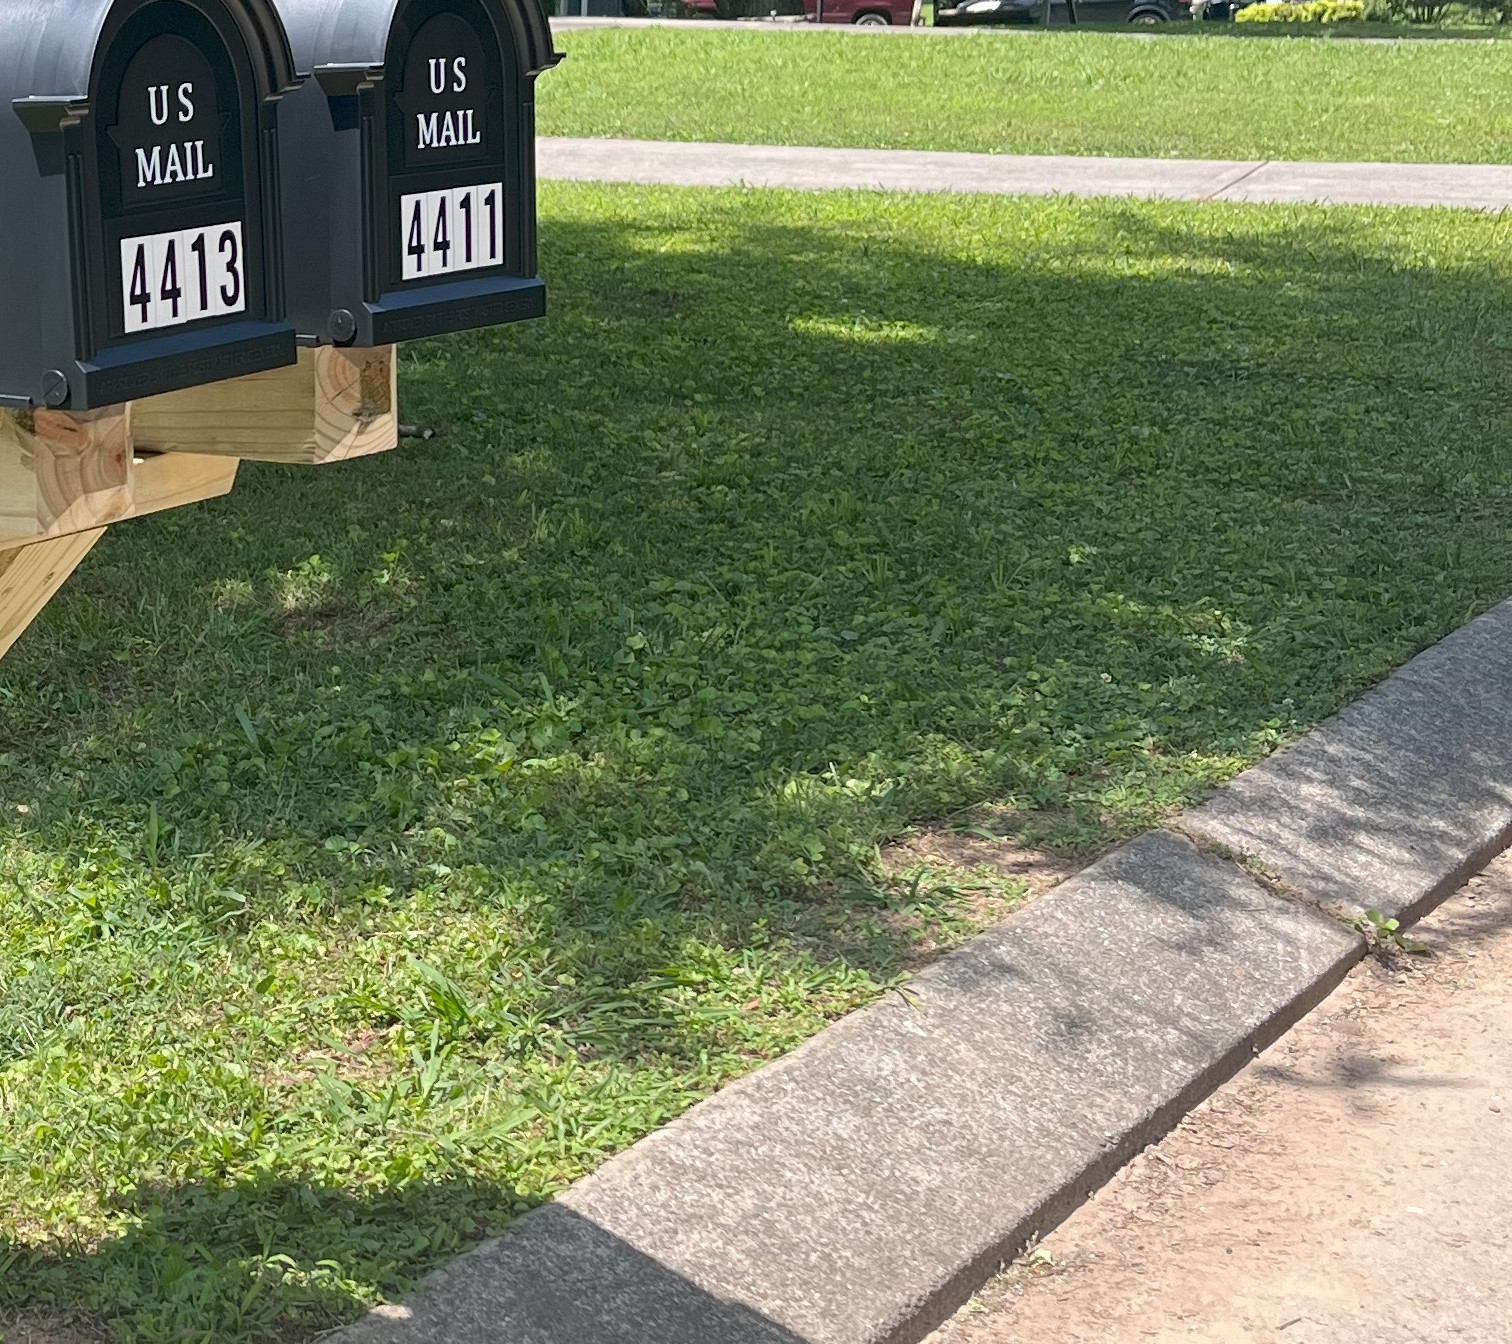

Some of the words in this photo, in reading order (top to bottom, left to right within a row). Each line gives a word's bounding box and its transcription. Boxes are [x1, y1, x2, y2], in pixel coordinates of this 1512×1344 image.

[416, 109, 481, 149] MAIL
[135, 140, 214, 188] MAIL
[407, 188, 498, 273] 4411
[128, 228, 241, 324] 4413
